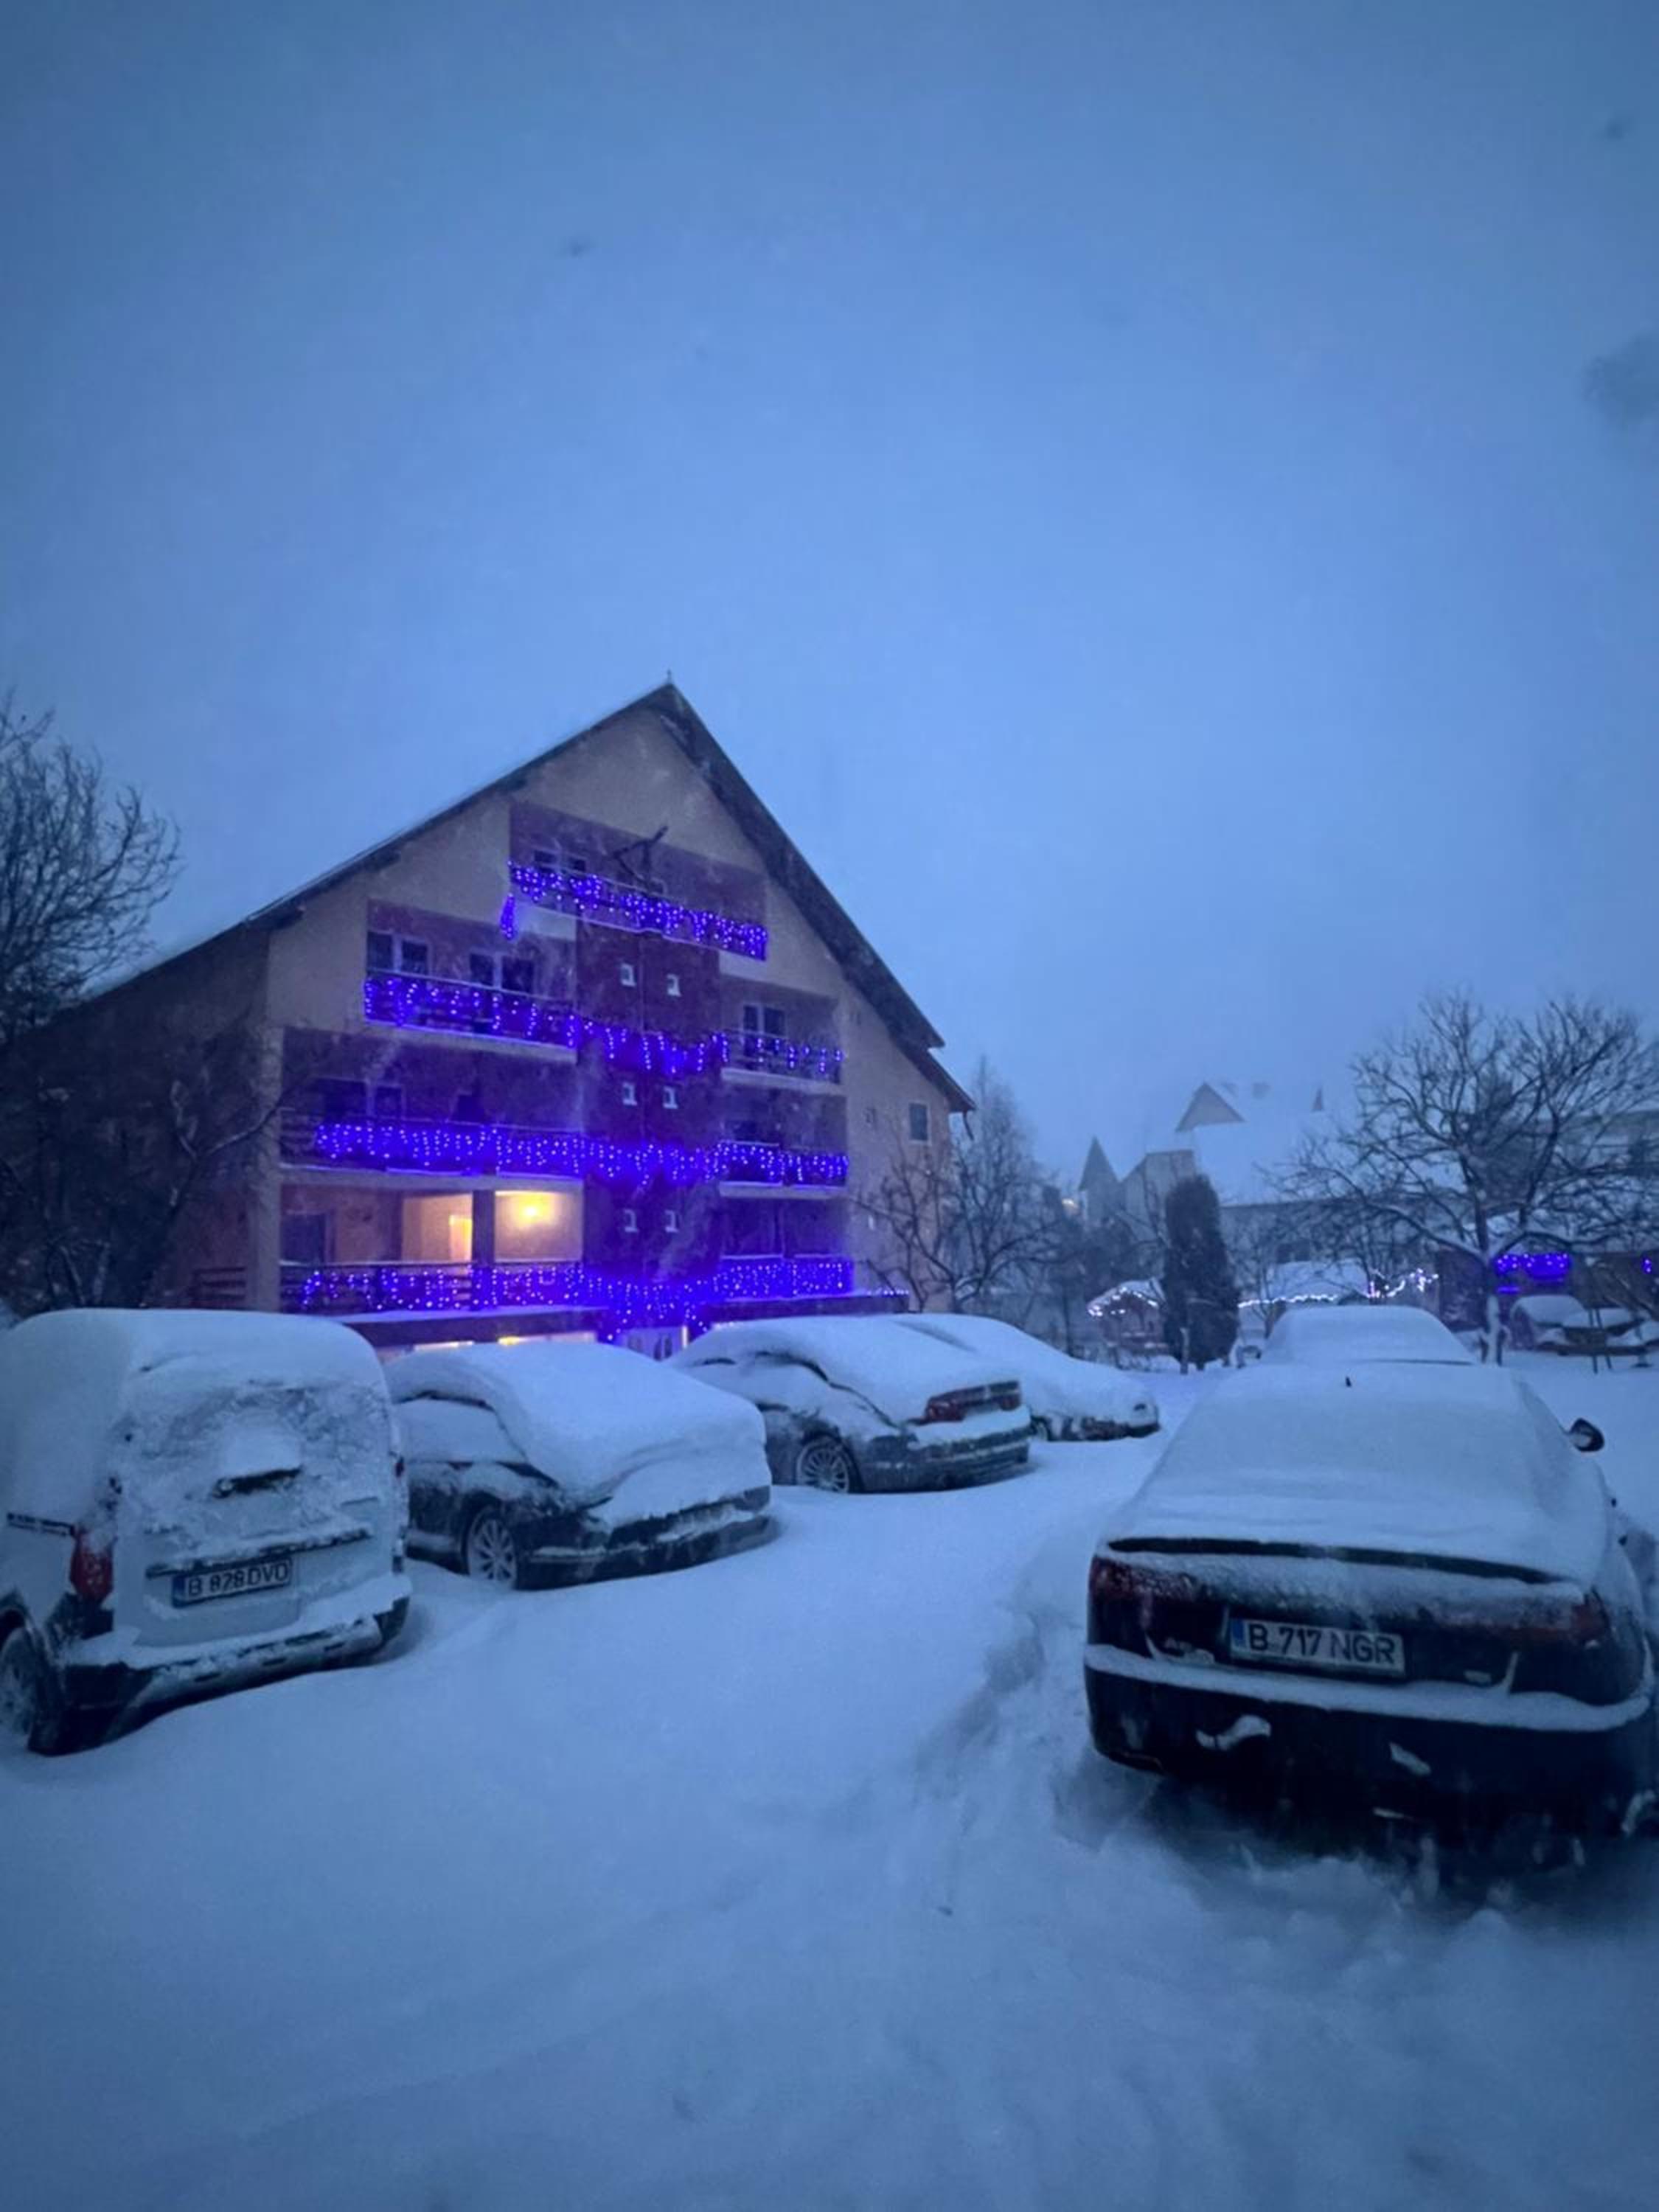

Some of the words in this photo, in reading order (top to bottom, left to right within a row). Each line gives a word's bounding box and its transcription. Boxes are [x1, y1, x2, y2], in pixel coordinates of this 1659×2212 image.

[189, 1578, 202, 1596] B
[1250, 1624, 1267, 1651] B
[1280, 1627, 1321, 1656] 717
[1331, 1633, 1394, 1663] NGR
